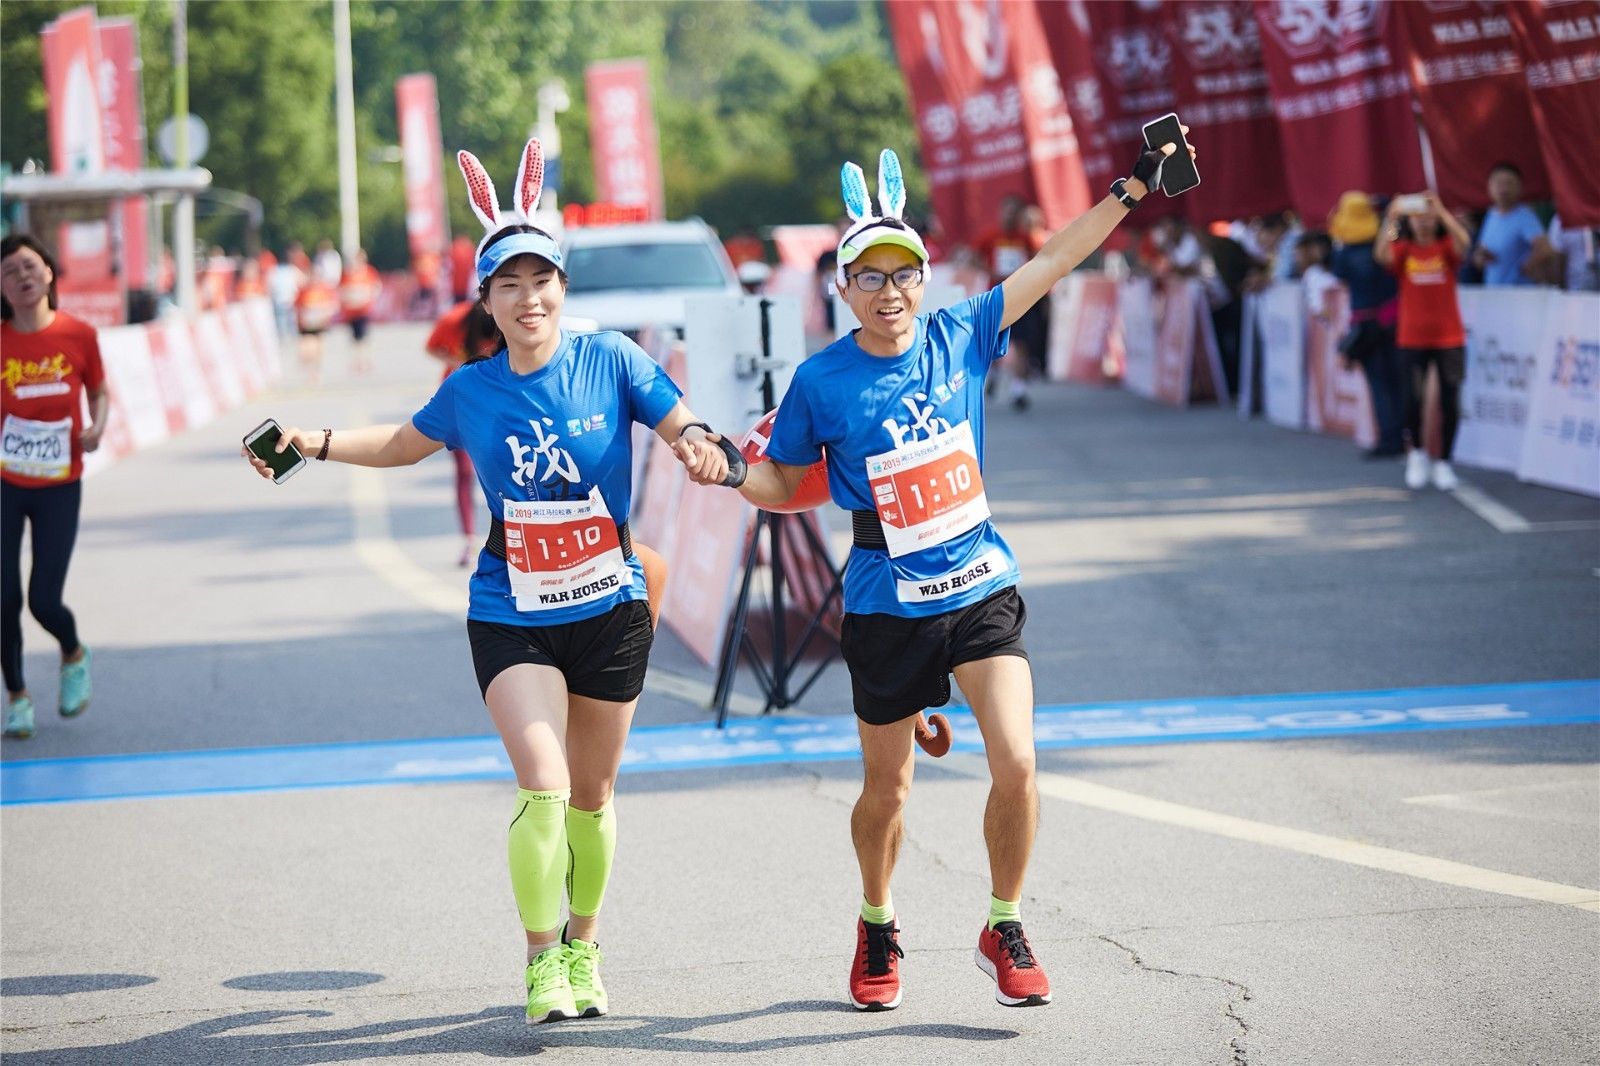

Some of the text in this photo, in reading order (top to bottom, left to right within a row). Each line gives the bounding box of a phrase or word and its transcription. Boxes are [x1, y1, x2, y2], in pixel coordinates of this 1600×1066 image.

[3, 432, 62, 462] C20120
[538, 591, 570, 604] WAR
[571, 574, 620, 600] HORSE
[919, 561, 992, 597] WAR HORSE
